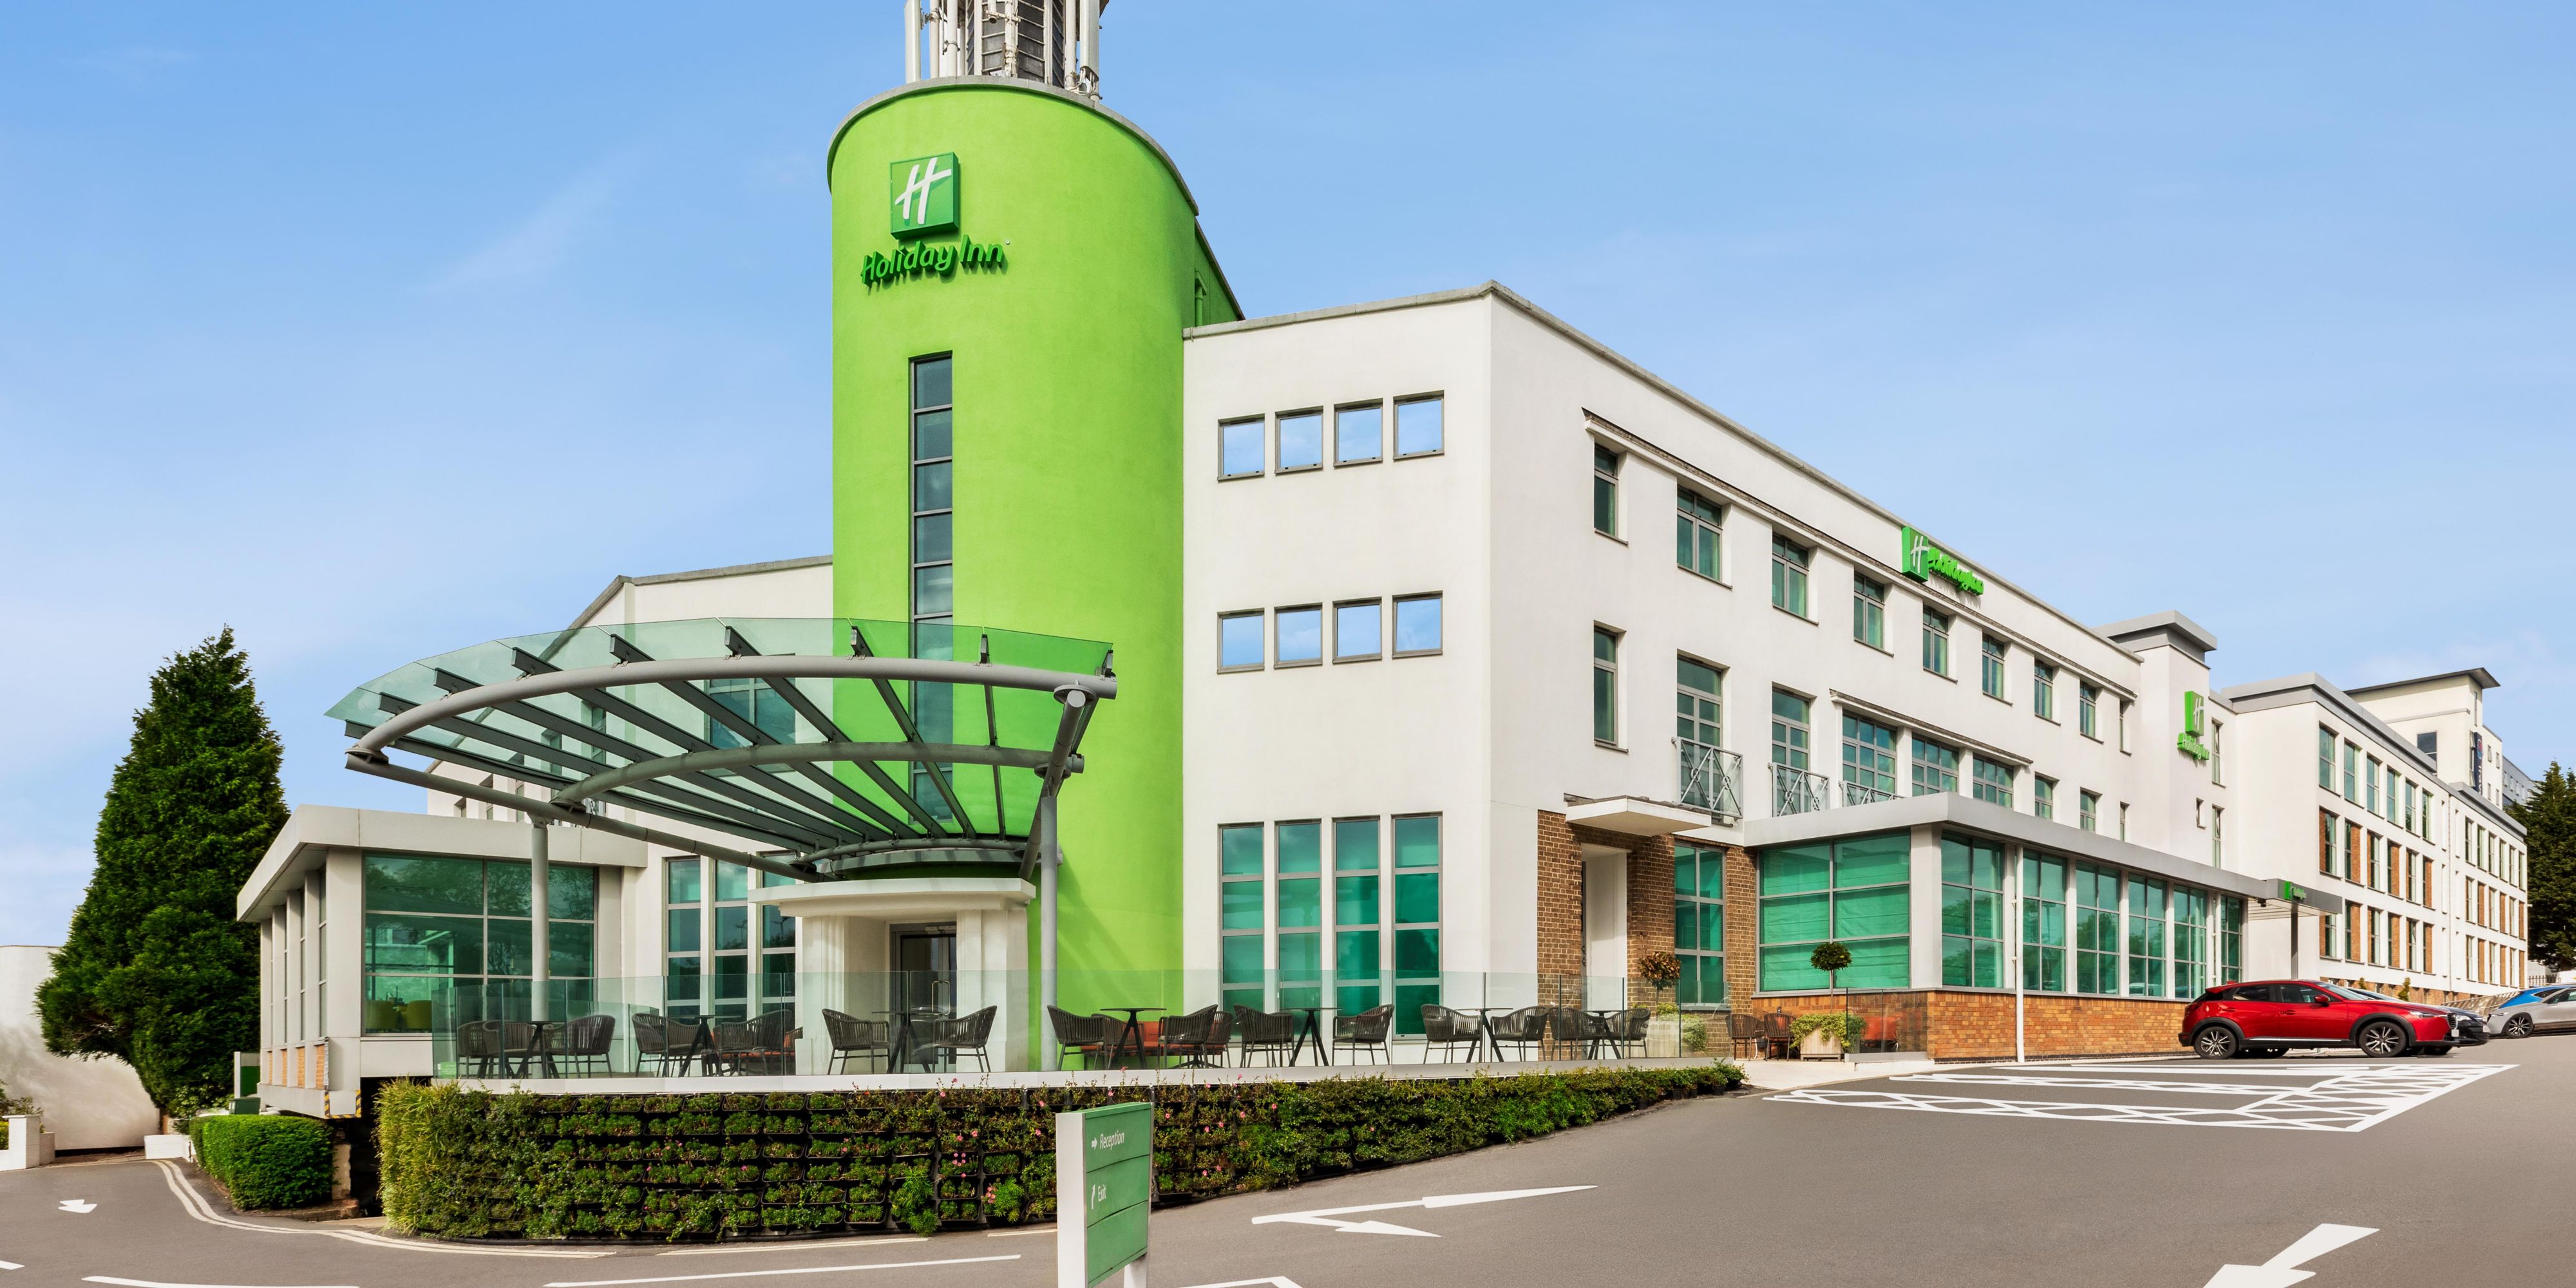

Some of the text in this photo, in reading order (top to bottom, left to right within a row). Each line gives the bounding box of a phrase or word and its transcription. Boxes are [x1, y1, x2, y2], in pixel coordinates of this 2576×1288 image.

[895, 156, 952, 225] H
[861, 234, 1005, 286] Holiday Inn
[1099, 1130, 1124, 1151] Reception
[1097, 1184, 1106, 1202] Exit
